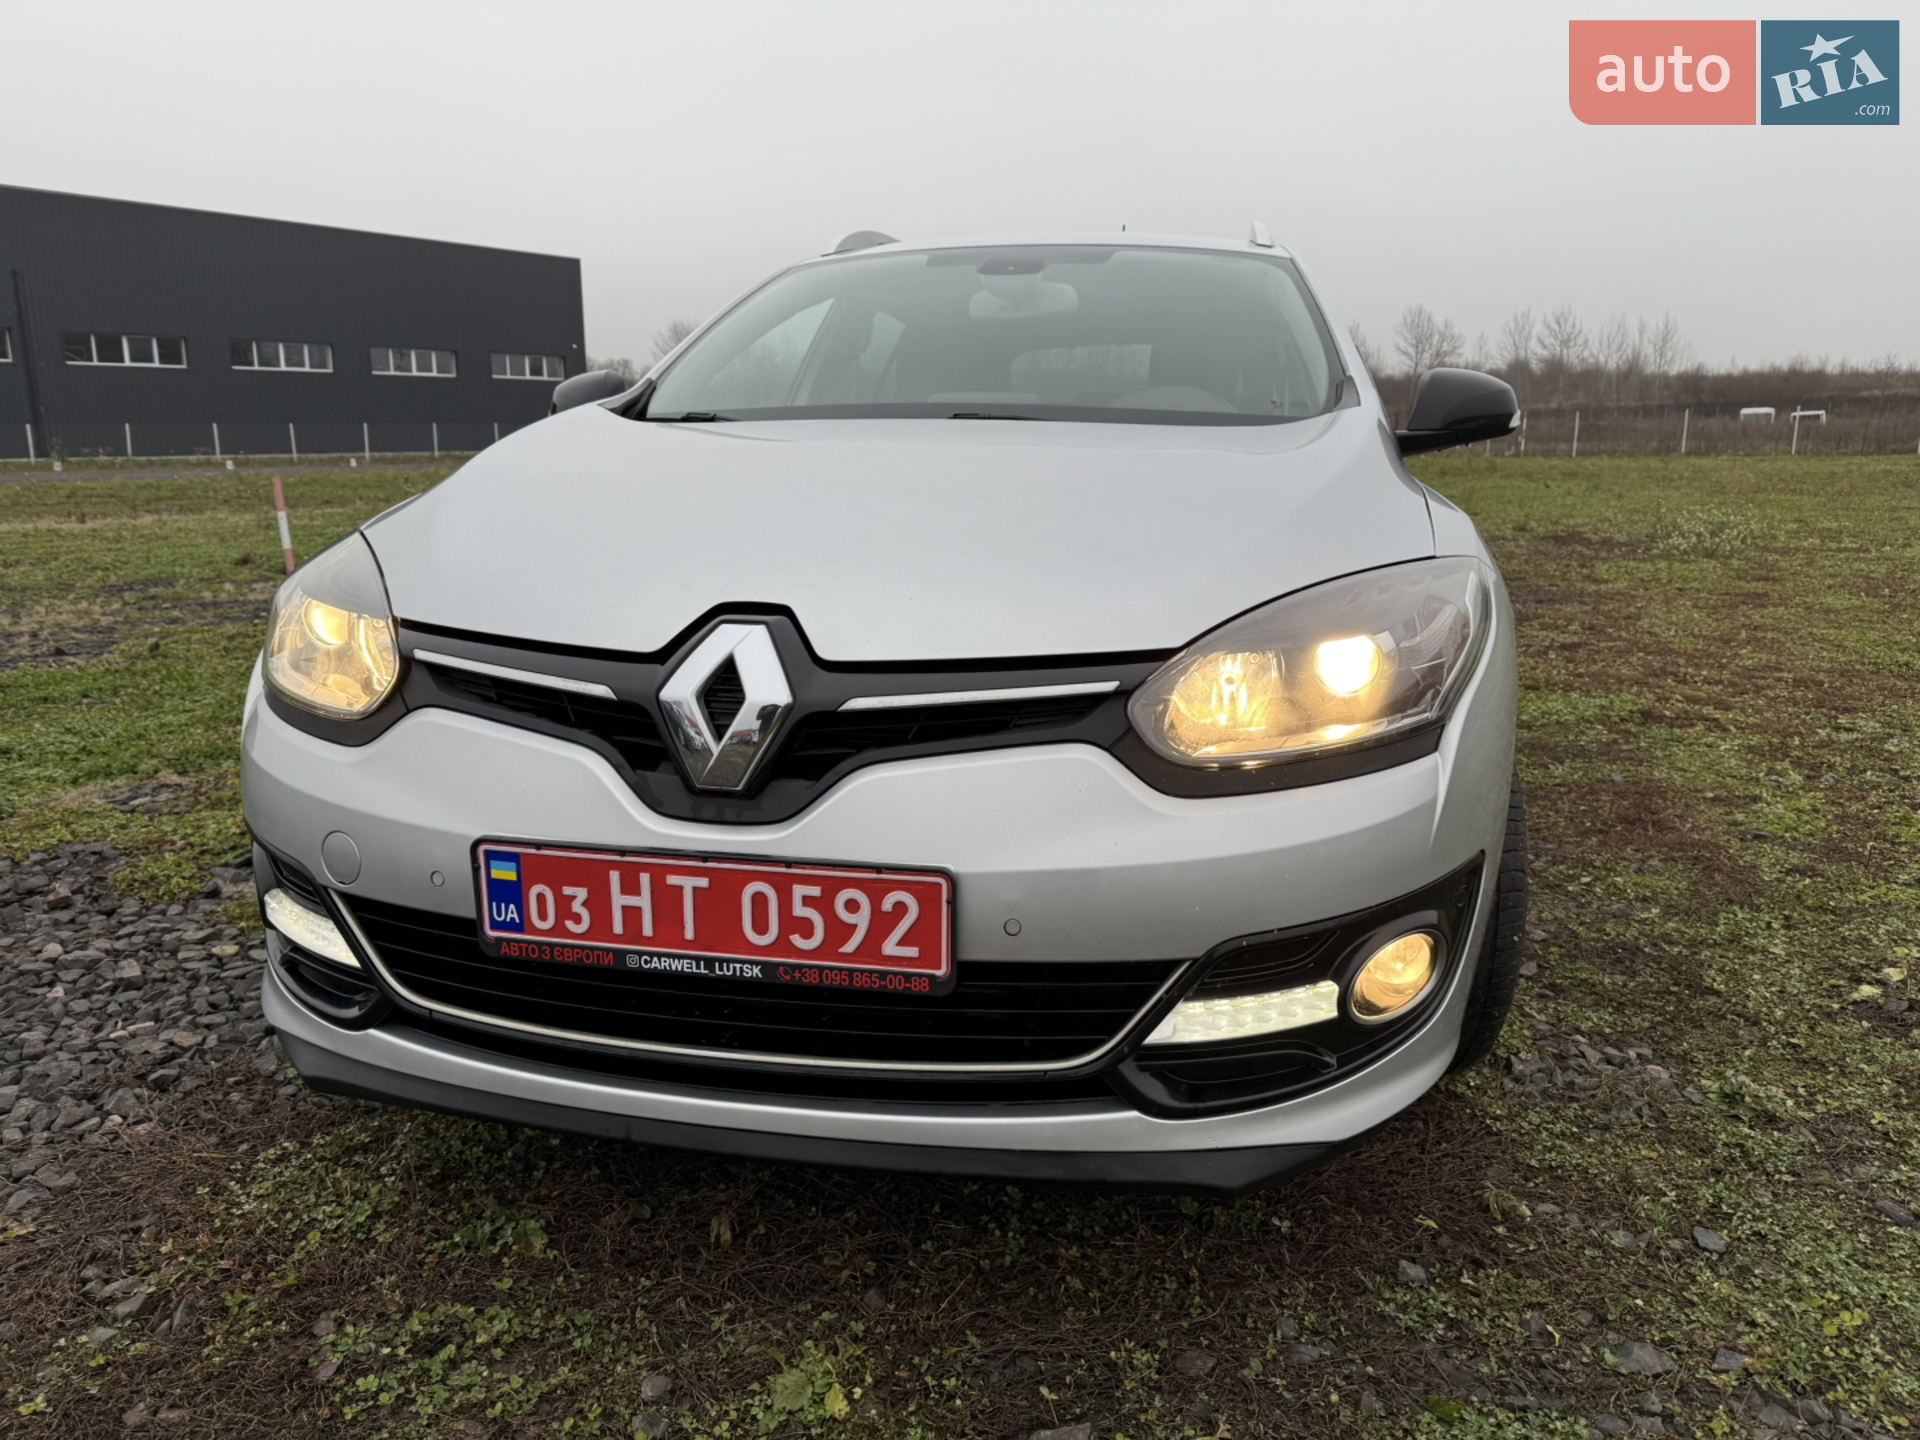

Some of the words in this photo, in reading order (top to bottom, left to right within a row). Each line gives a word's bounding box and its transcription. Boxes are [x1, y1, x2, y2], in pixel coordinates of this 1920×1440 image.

[492, 901, 520, 923] UA
[528, 884, 591, 934] 03
[609, 870, 710, 941] HT
[741, 881, 919, 958] 0592
[501, 942, 539, 958] АВТО
[553, 947, 614, 966] ЄВРОПИ
[641, 955, 763, 978] CARWELL_LUTSK
[793, 968, 819, 984] +38
[823, 970, 849, 986] 095
[852, 972, 931, 993] 865-00-88
